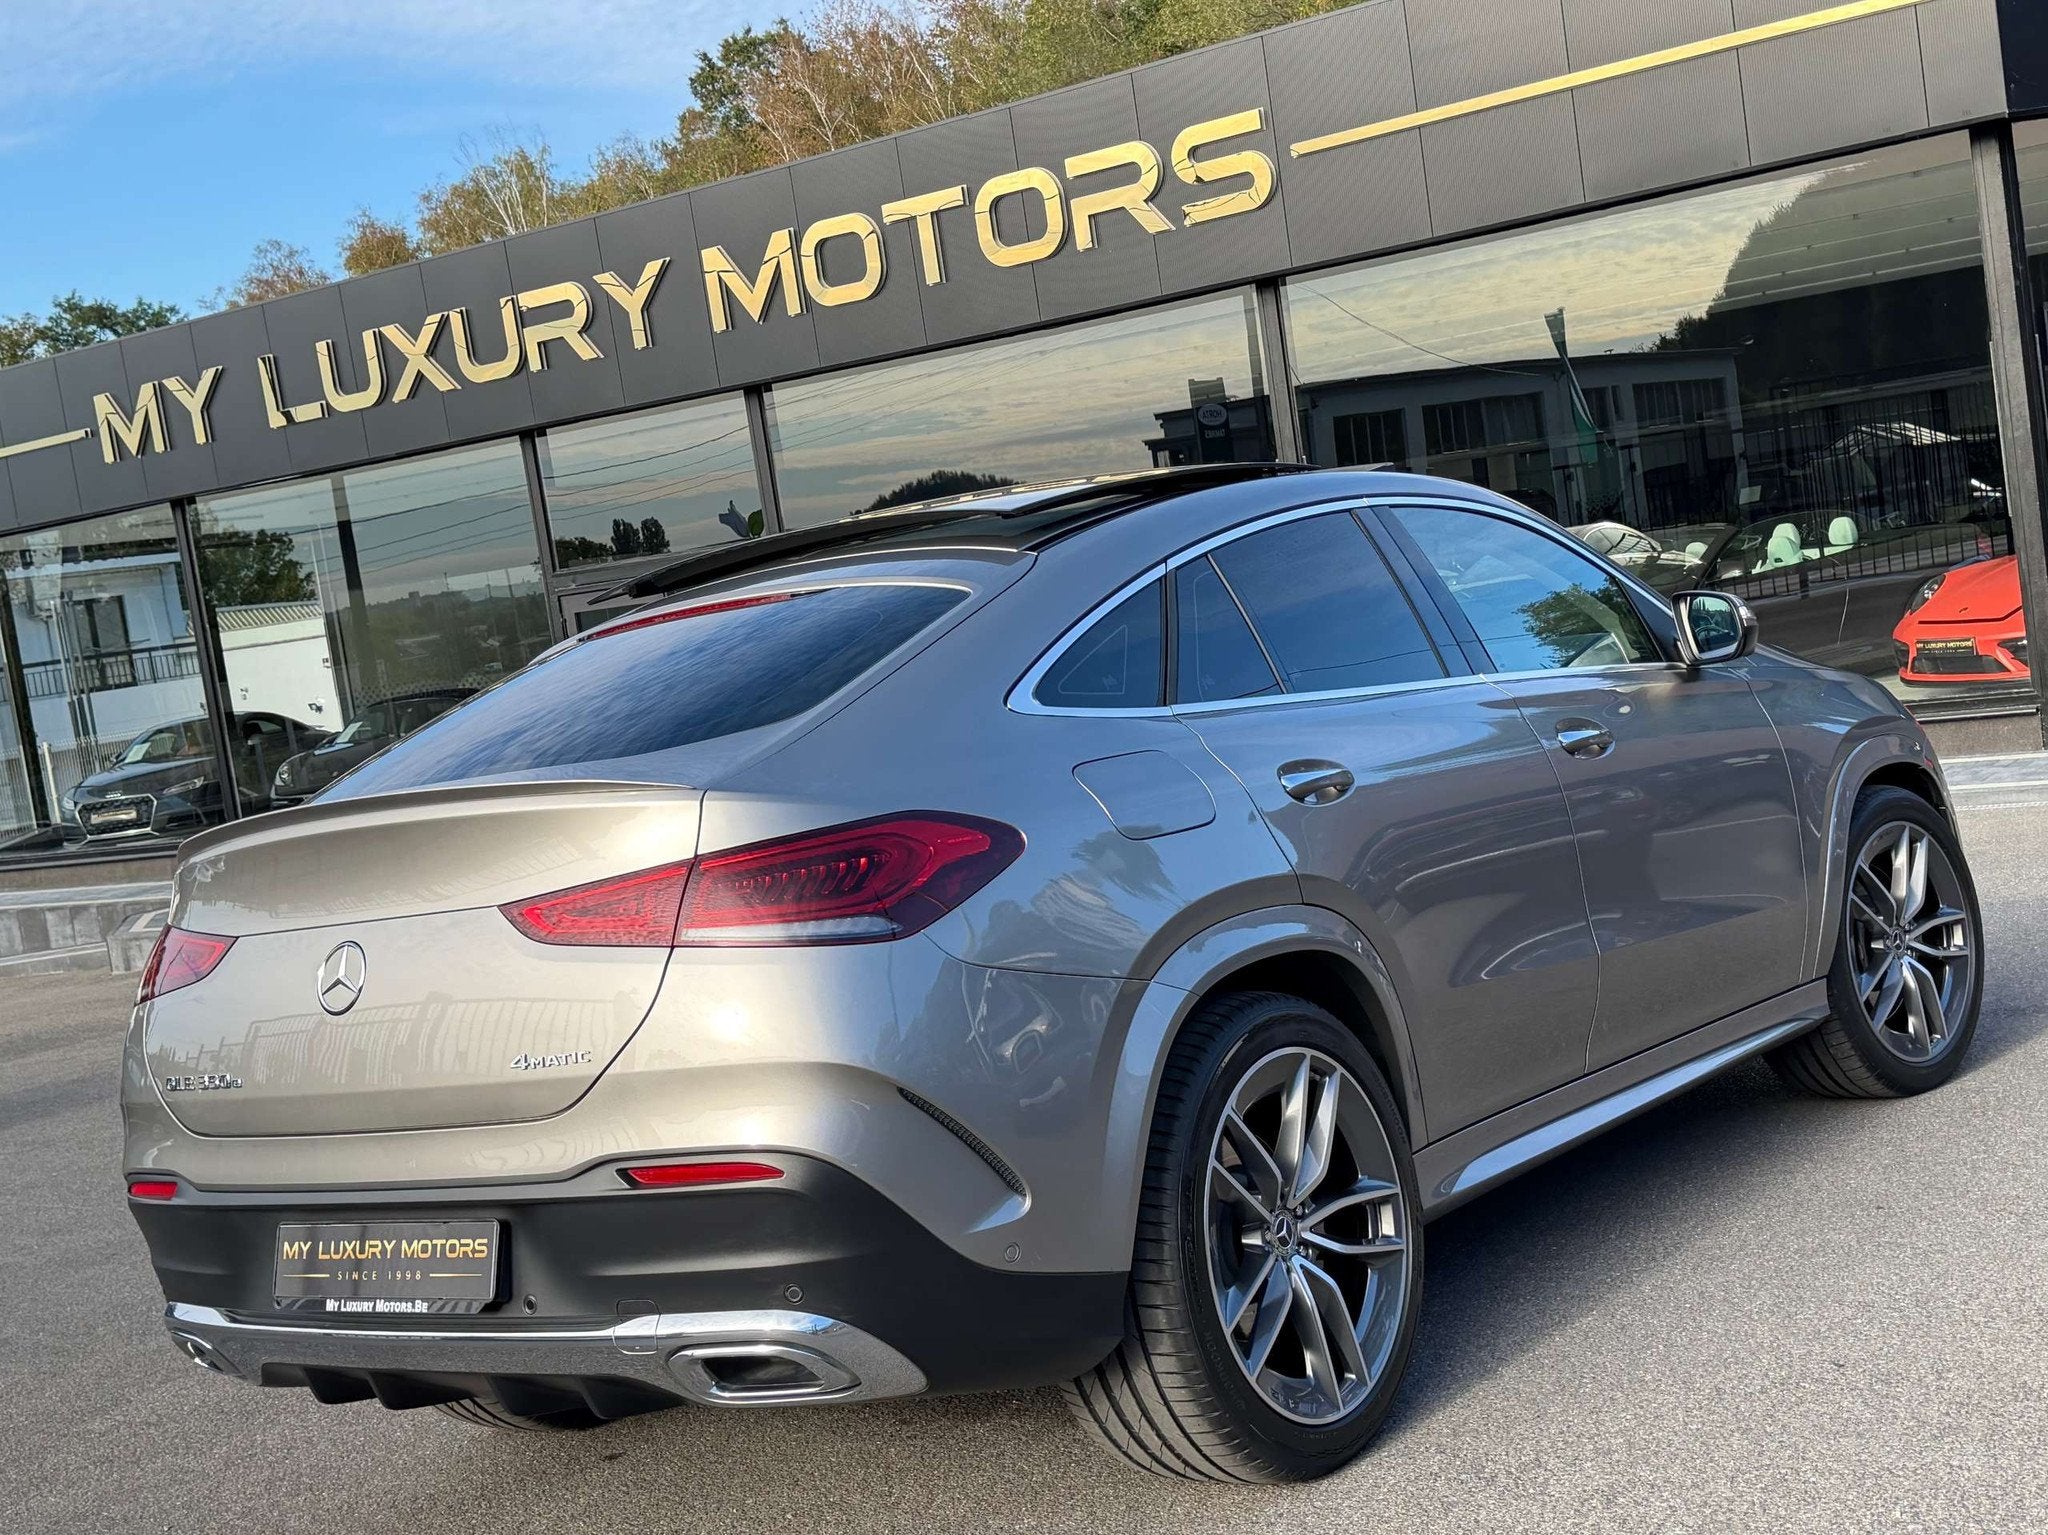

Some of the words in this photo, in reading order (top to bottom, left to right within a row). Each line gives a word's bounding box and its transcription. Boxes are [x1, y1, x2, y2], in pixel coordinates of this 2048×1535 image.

[93, 365, 223, 463] MY
[257, 256, 670, 429] LUXURY
[700, 107, 1277, 334] MOTORS
[510, 1050, 592, 1070] 4MATIC
[282, 1241, 312, 1260] MY
[318, 1239, 396, 1260] LUXURY
[401, 1238, 488, 1259] MOTORS
[337, 1271, 378, 1280] SINCE
[388, 1270, 422, 1280] 1998
